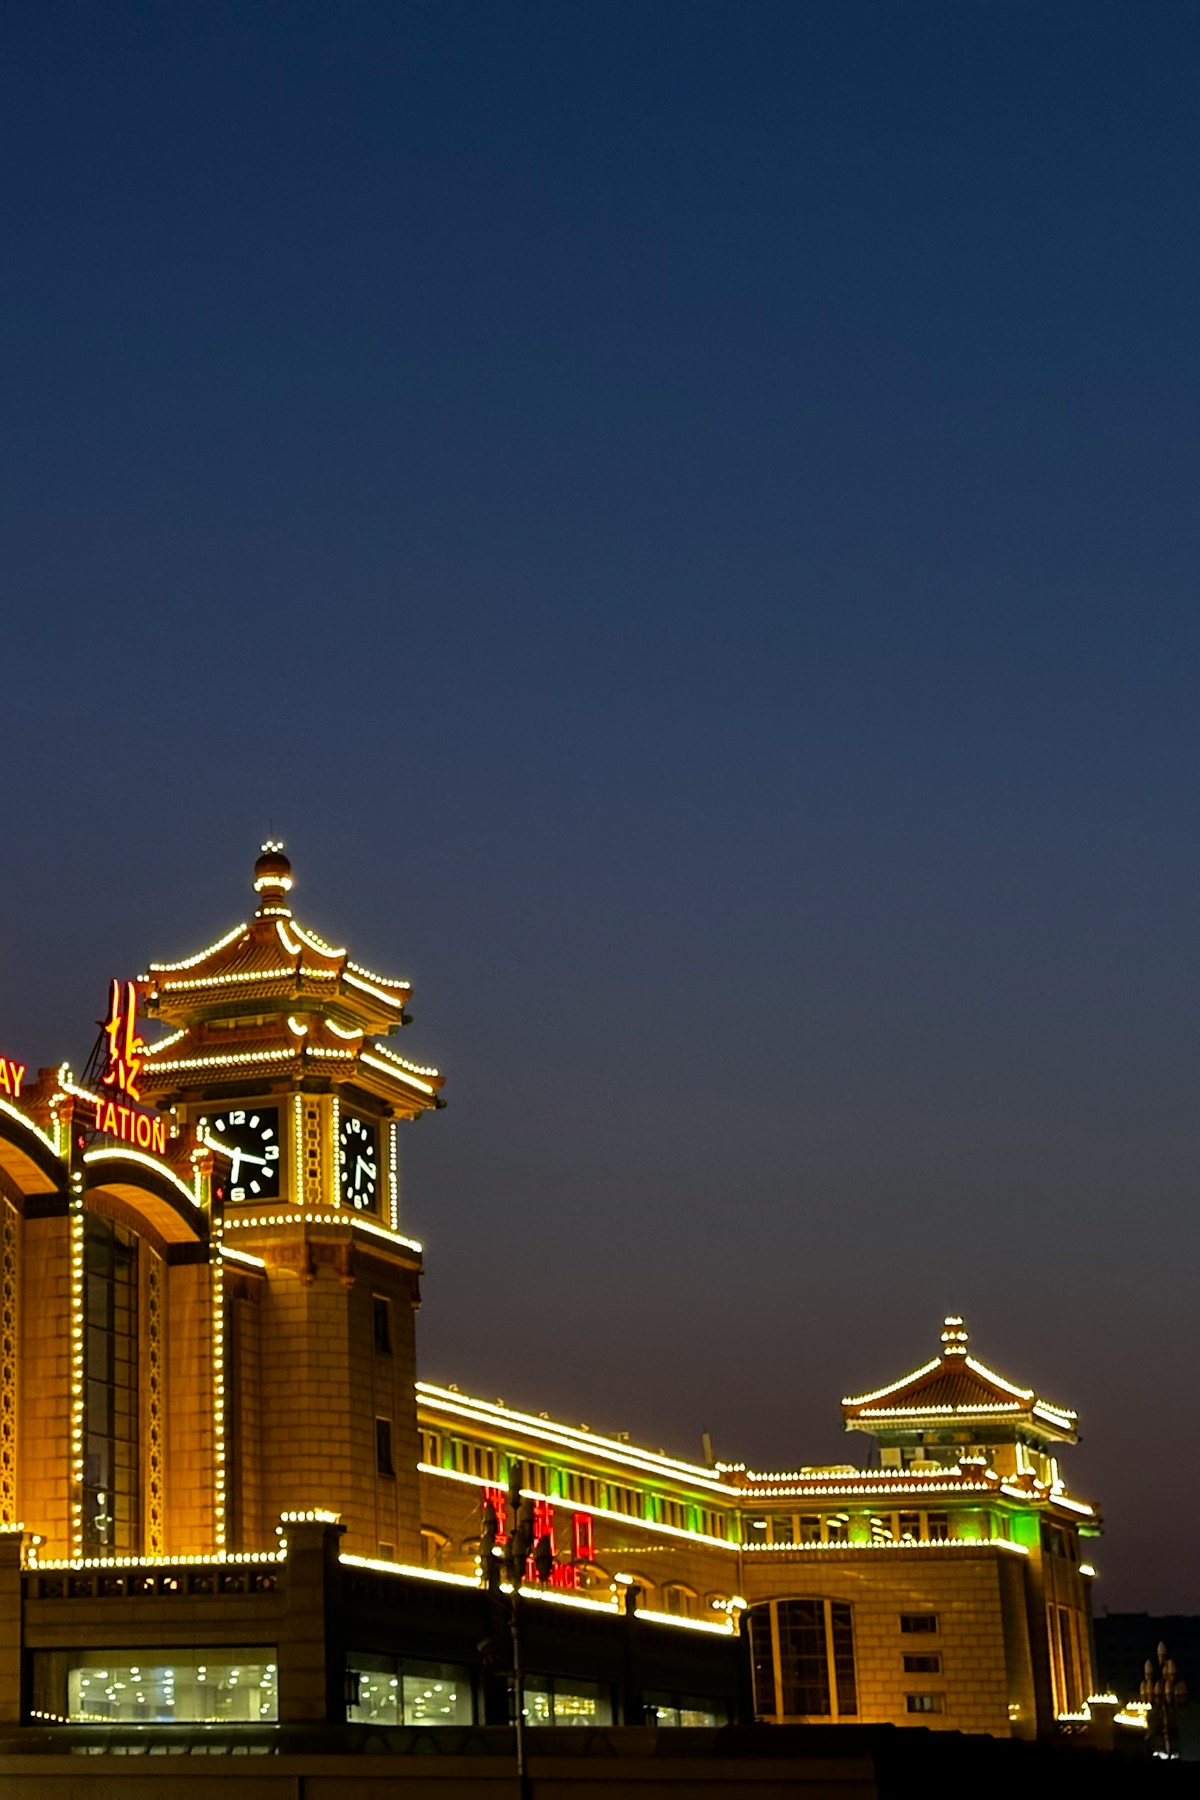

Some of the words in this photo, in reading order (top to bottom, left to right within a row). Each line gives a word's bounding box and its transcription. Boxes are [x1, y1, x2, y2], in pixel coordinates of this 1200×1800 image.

[229, 1110, 246, 1125] 12
[94, 1100, 166, 1155] TATION
[265, 1145, 279, 1160] 3
[230, 1187, 246, 1202] 6
